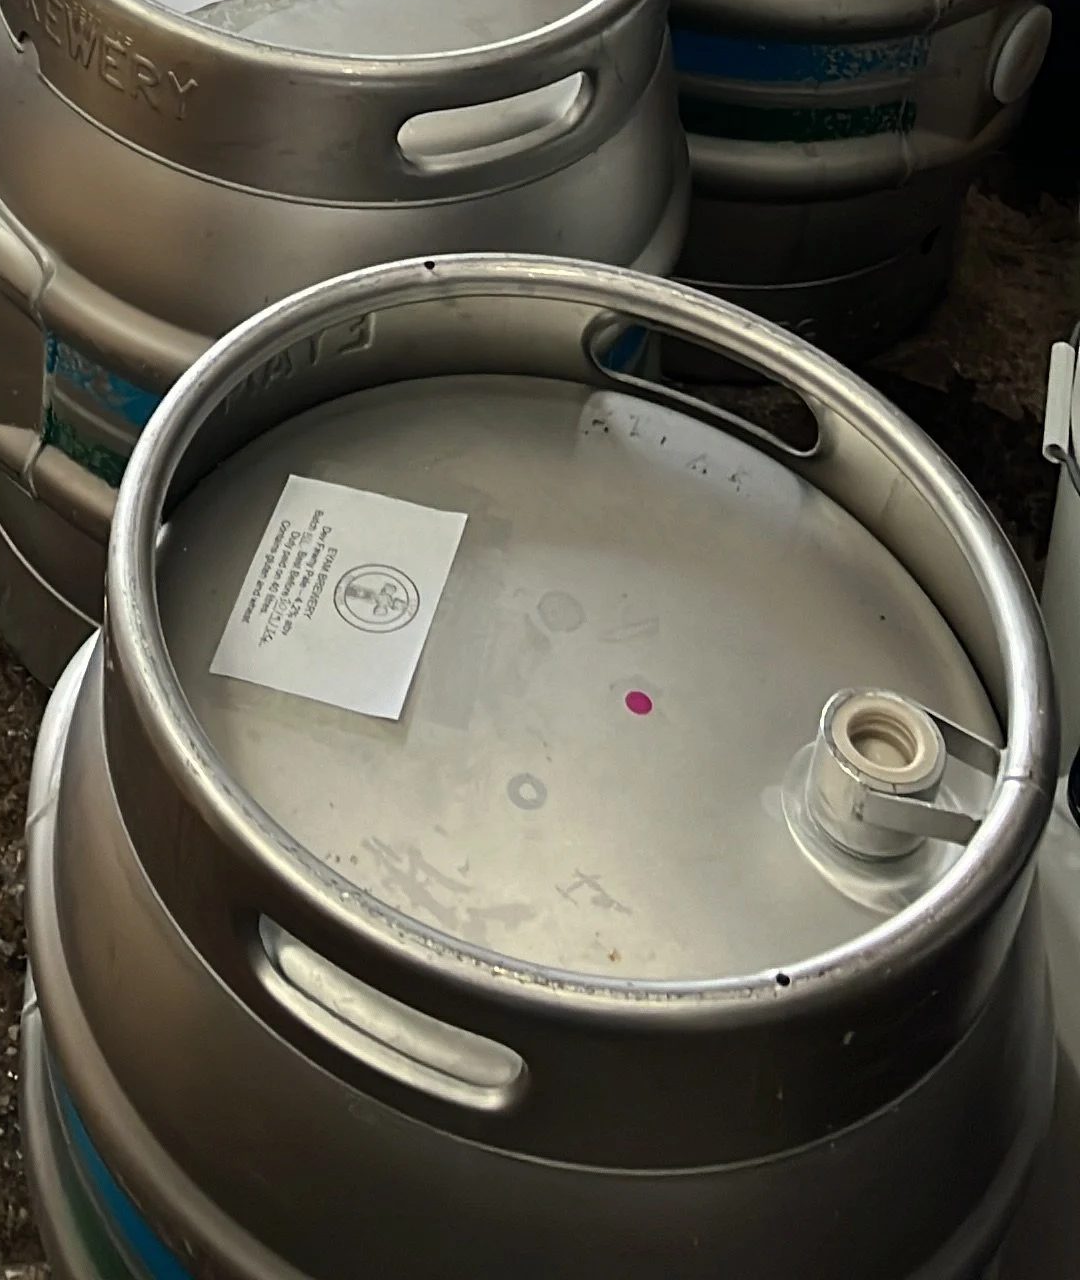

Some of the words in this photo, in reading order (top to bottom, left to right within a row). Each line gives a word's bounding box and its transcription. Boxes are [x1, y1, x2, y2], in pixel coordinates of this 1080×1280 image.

[269, 520, 291, 554] Contains
[286, 530, 301, 549] Duty
[259, 554, 275, 578] gluten
[293, 550, 307, 569] Best
[321, 547, 337, 572] EYAM
[252, 580, 265, 596] and
[281, 569, 299, 597] Before
[304, 572, 327, 620] BREWERY
